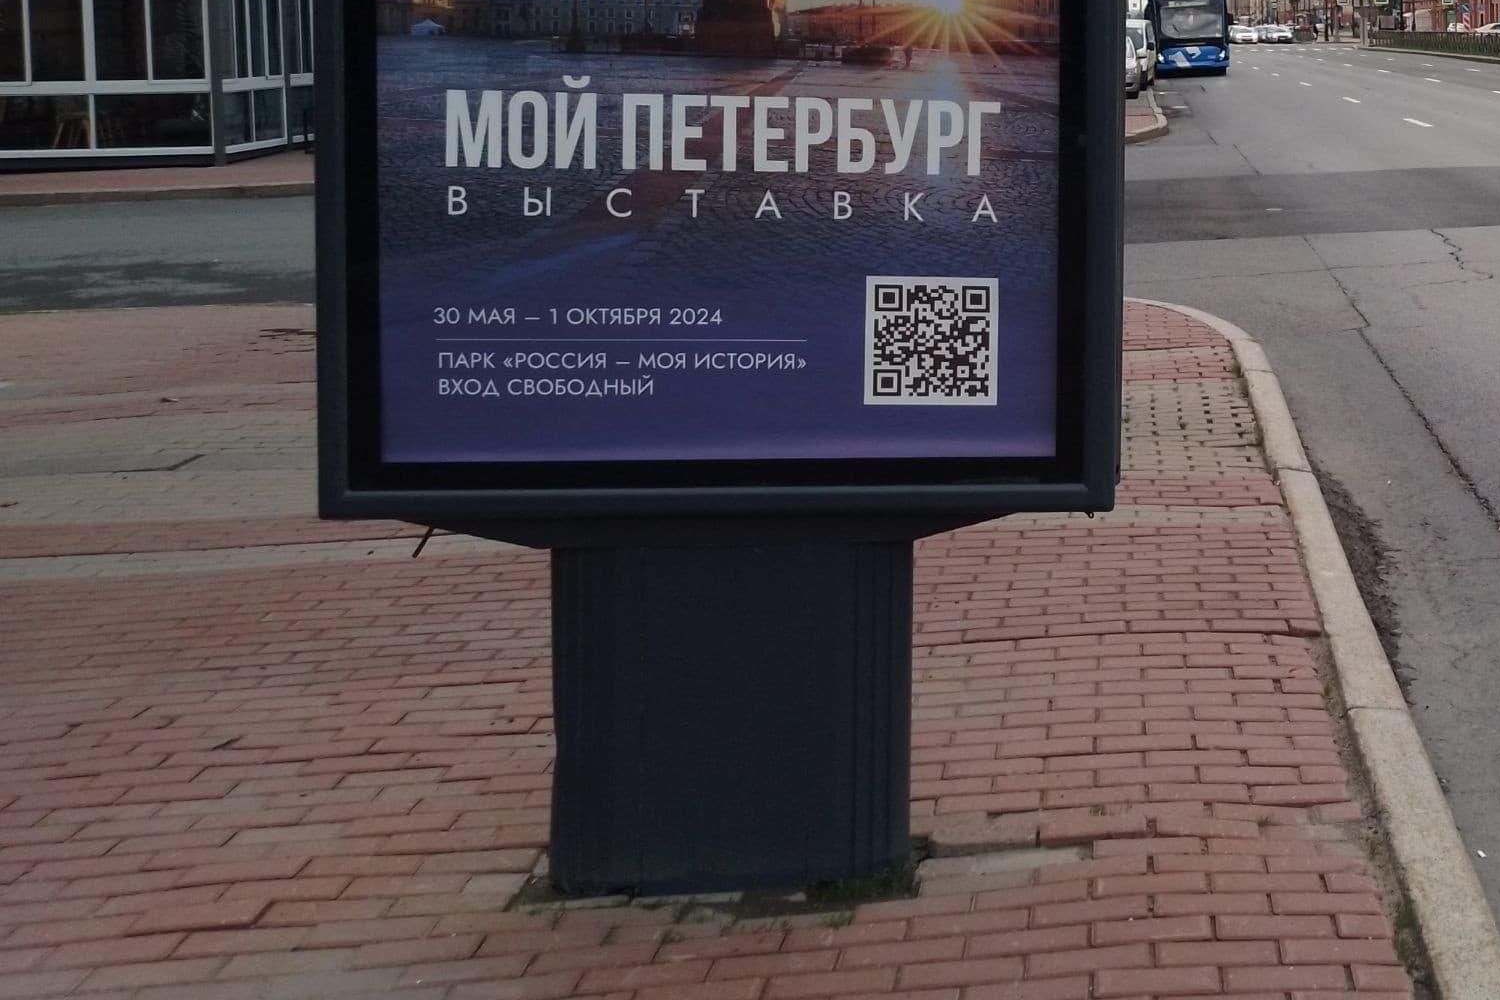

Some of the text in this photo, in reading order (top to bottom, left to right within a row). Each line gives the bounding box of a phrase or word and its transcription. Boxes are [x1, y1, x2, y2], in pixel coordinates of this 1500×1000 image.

[445, 75, 1001, 176] МОЙ ПЕТЕРБУРГ
[447, 185, 998, 223] ВЫСТАВКА
[433, 307, 461, 325] 30
[468, 307, 516, 325] МАЯ
[549, 308, 558, 325] 1
[566, 307, 661, 326] ОКТЯБРЯ
[668, 307, 723, 326] 2024
[438, 352, 496, 369] ПАРК
[503, 352, 607, 369] «РОССИЯ
[638, 352, 686, 370] МОЯ
[694, 352, 807, 370] ИСТОРИЯ»
[438, 374, 654, 398] ВХОД СВОБОДНЫЙ
